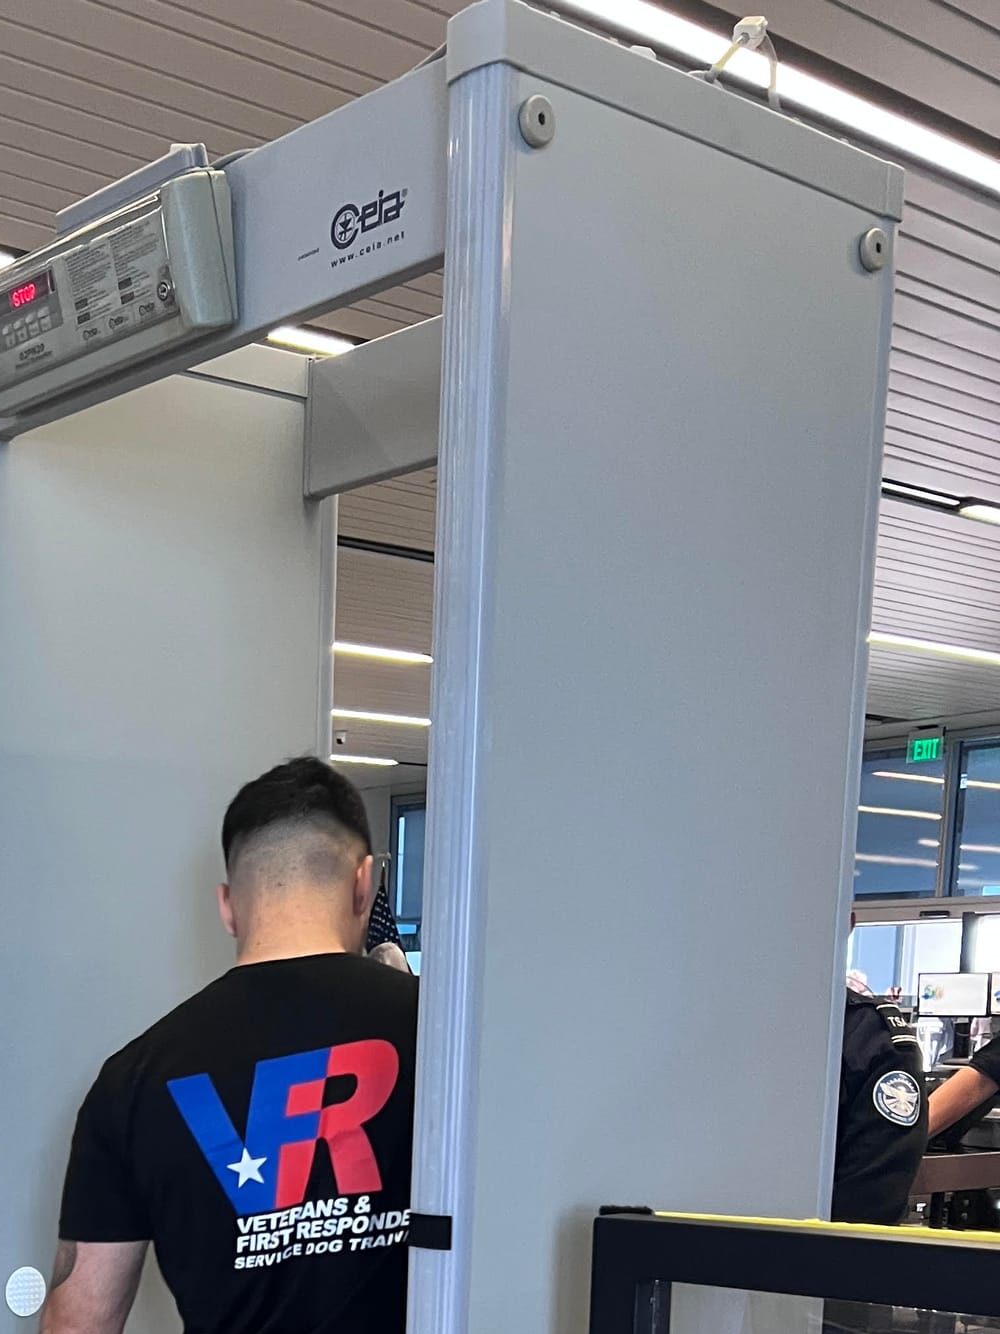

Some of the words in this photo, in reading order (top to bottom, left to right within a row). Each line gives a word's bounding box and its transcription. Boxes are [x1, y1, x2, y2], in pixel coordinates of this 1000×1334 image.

[331, 231, 405, 268] www.ceia.net
[11, 283, 36, 308] STOP
[914, 739, 939, 760] EXIT
[166, 1039, 399, 1216] VFR
[236, 1228, 295, 1254] FIRST
[296, 1209, 411, 1240] RESPONDE
[237, 1197, 349, 1234] VETERANS
[354, 1195, 371, 1214] &
[234, 1243, 302, 1270] SERVICE
[305, 1240, 343, 1255] DOG
